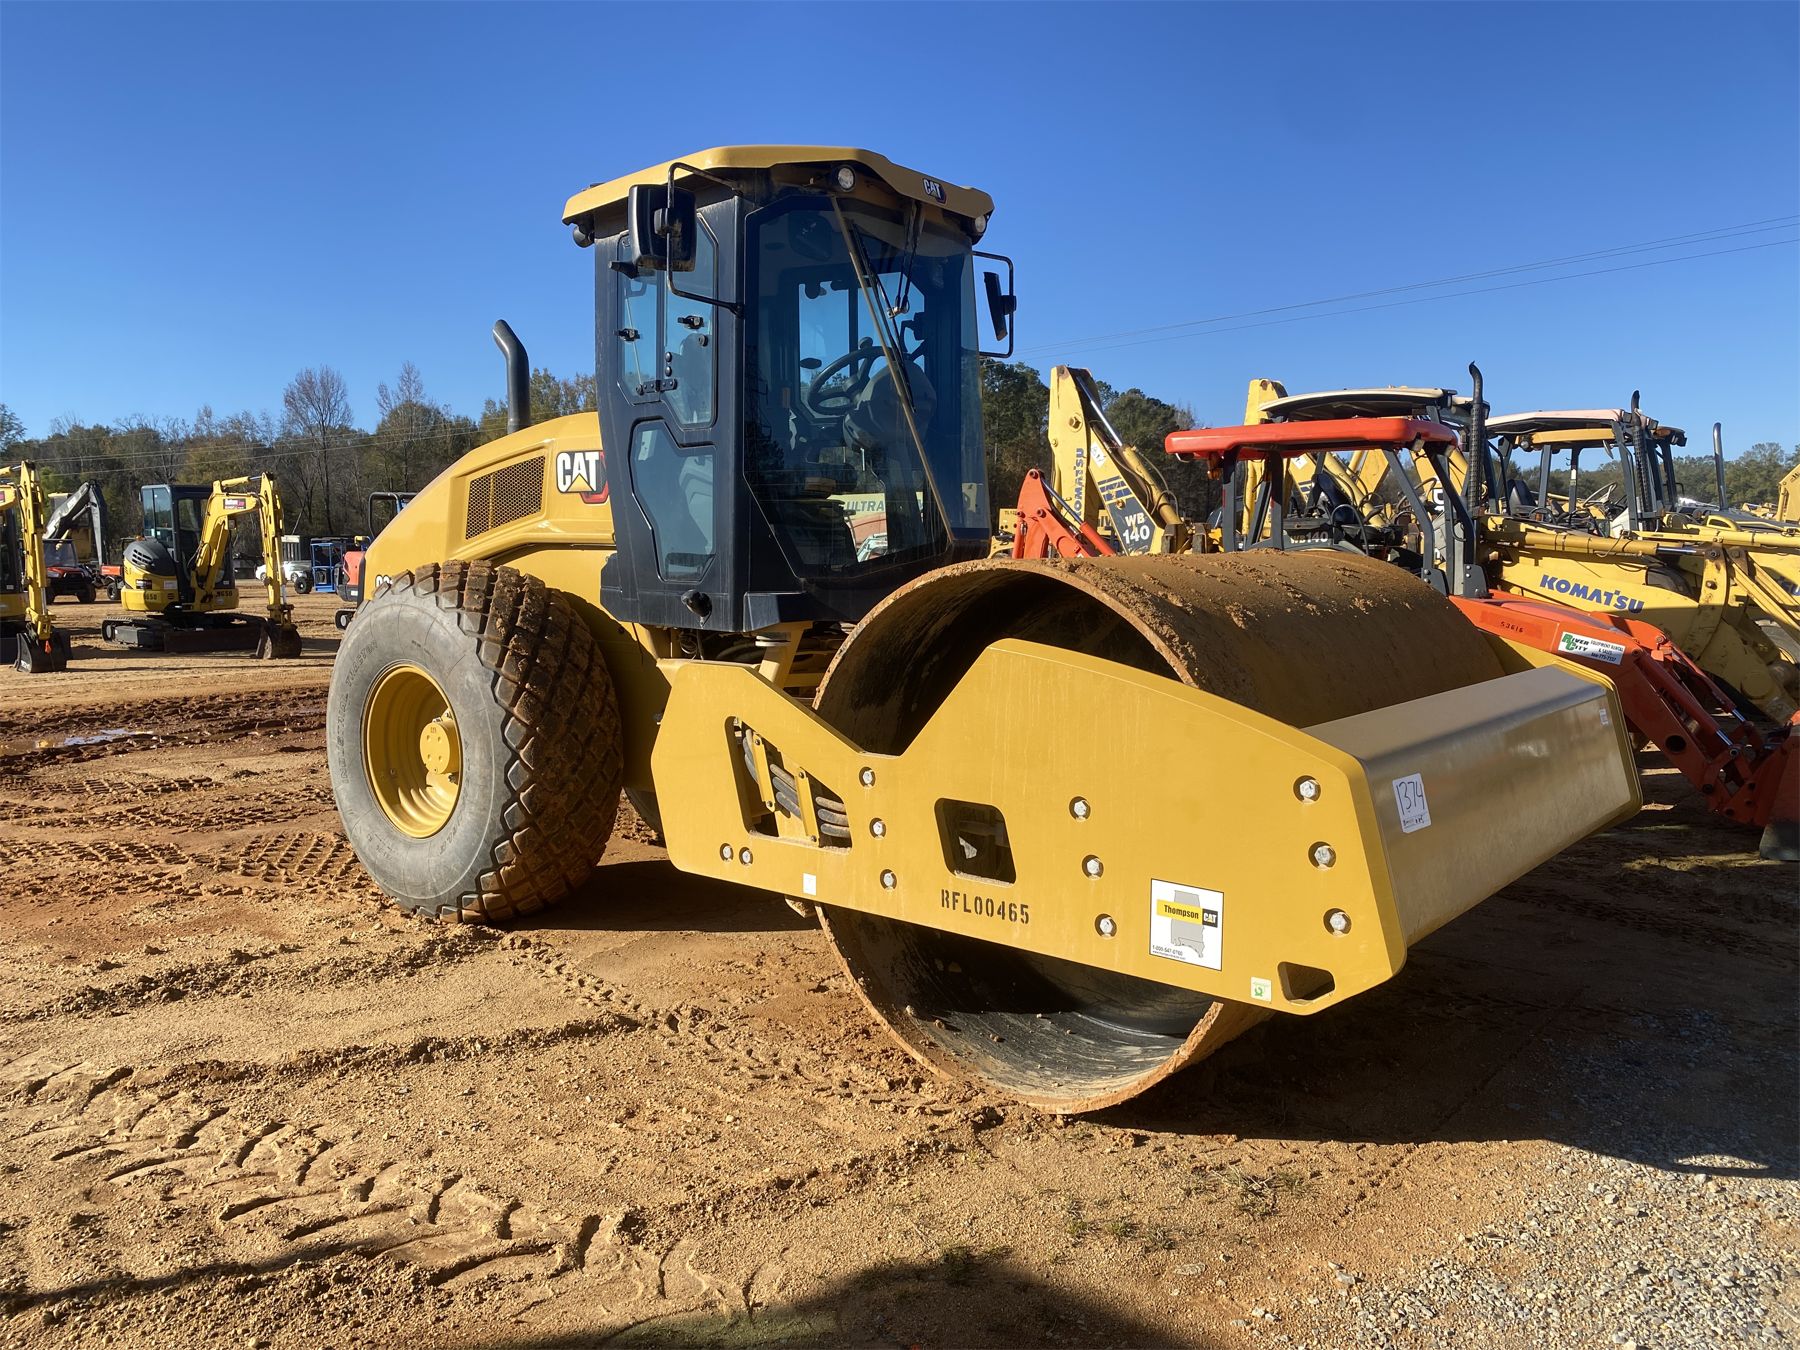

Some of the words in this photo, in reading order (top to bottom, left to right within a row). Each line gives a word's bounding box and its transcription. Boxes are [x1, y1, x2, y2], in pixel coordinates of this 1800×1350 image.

[923, 179, 942, 199] CAT
[557, 451, 600, 493] CAT
[1073, 448, 1084, 517] OMATSU
[1122, 525, 1150, 544] 140
[1125, 512, 1146, 527] WB
[1540, 574, 1645, 614] KOMATSU
[1396, 781, 1425, 815] 1374
[941, 889, 1030, 925] RFL00465
[1164, 904, 1200, 920] Thompson
[1203, 912, 1217, 924] CAT
